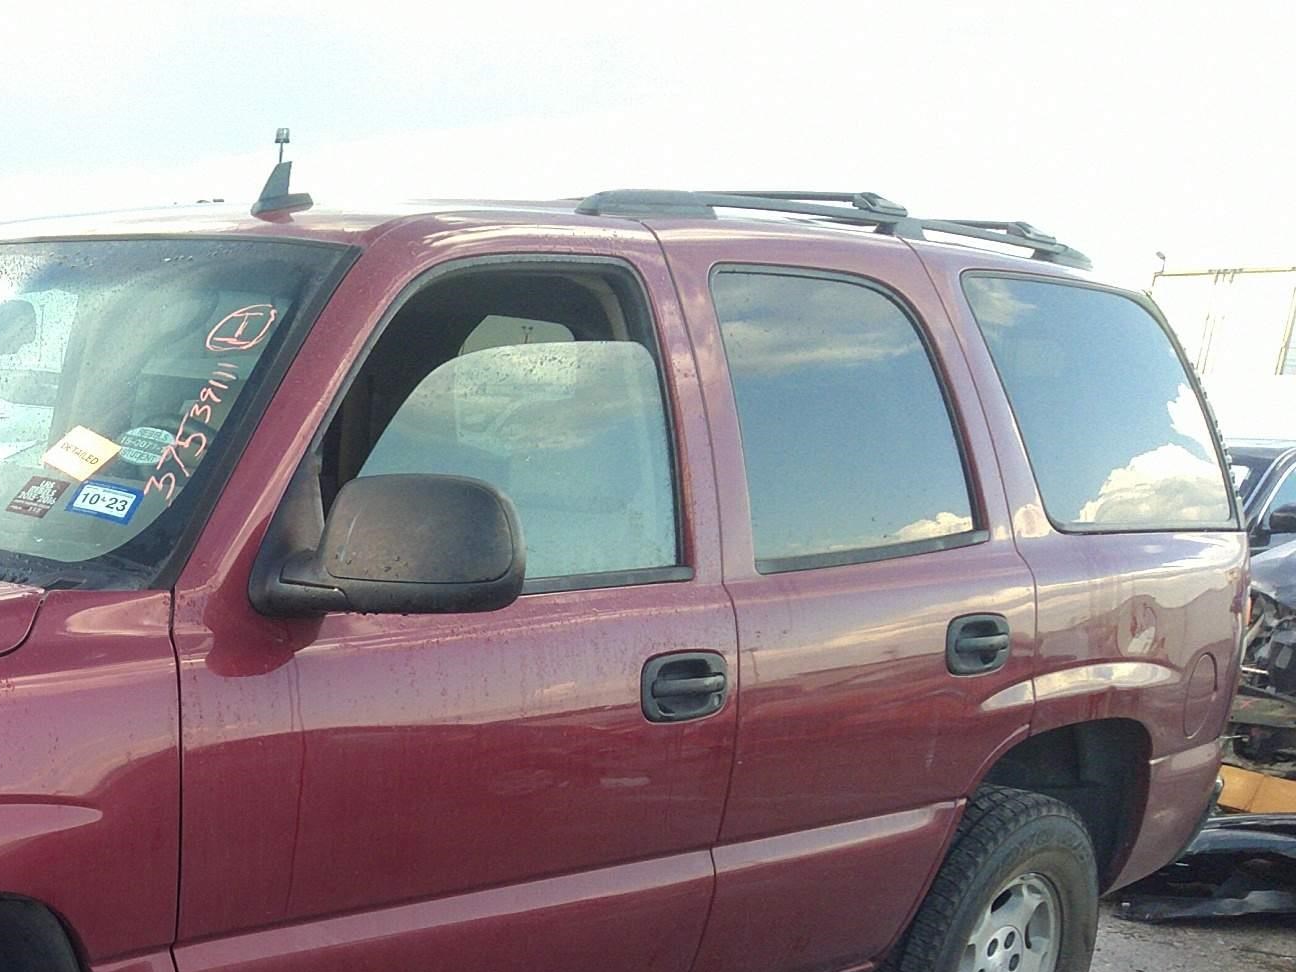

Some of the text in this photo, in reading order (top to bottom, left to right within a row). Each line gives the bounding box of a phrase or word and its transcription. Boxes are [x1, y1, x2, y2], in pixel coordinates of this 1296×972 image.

[59, 442, 99, 465] DETAILED
[81, 492, 101, 505] 10
[104, 497, 128, 512] 23
